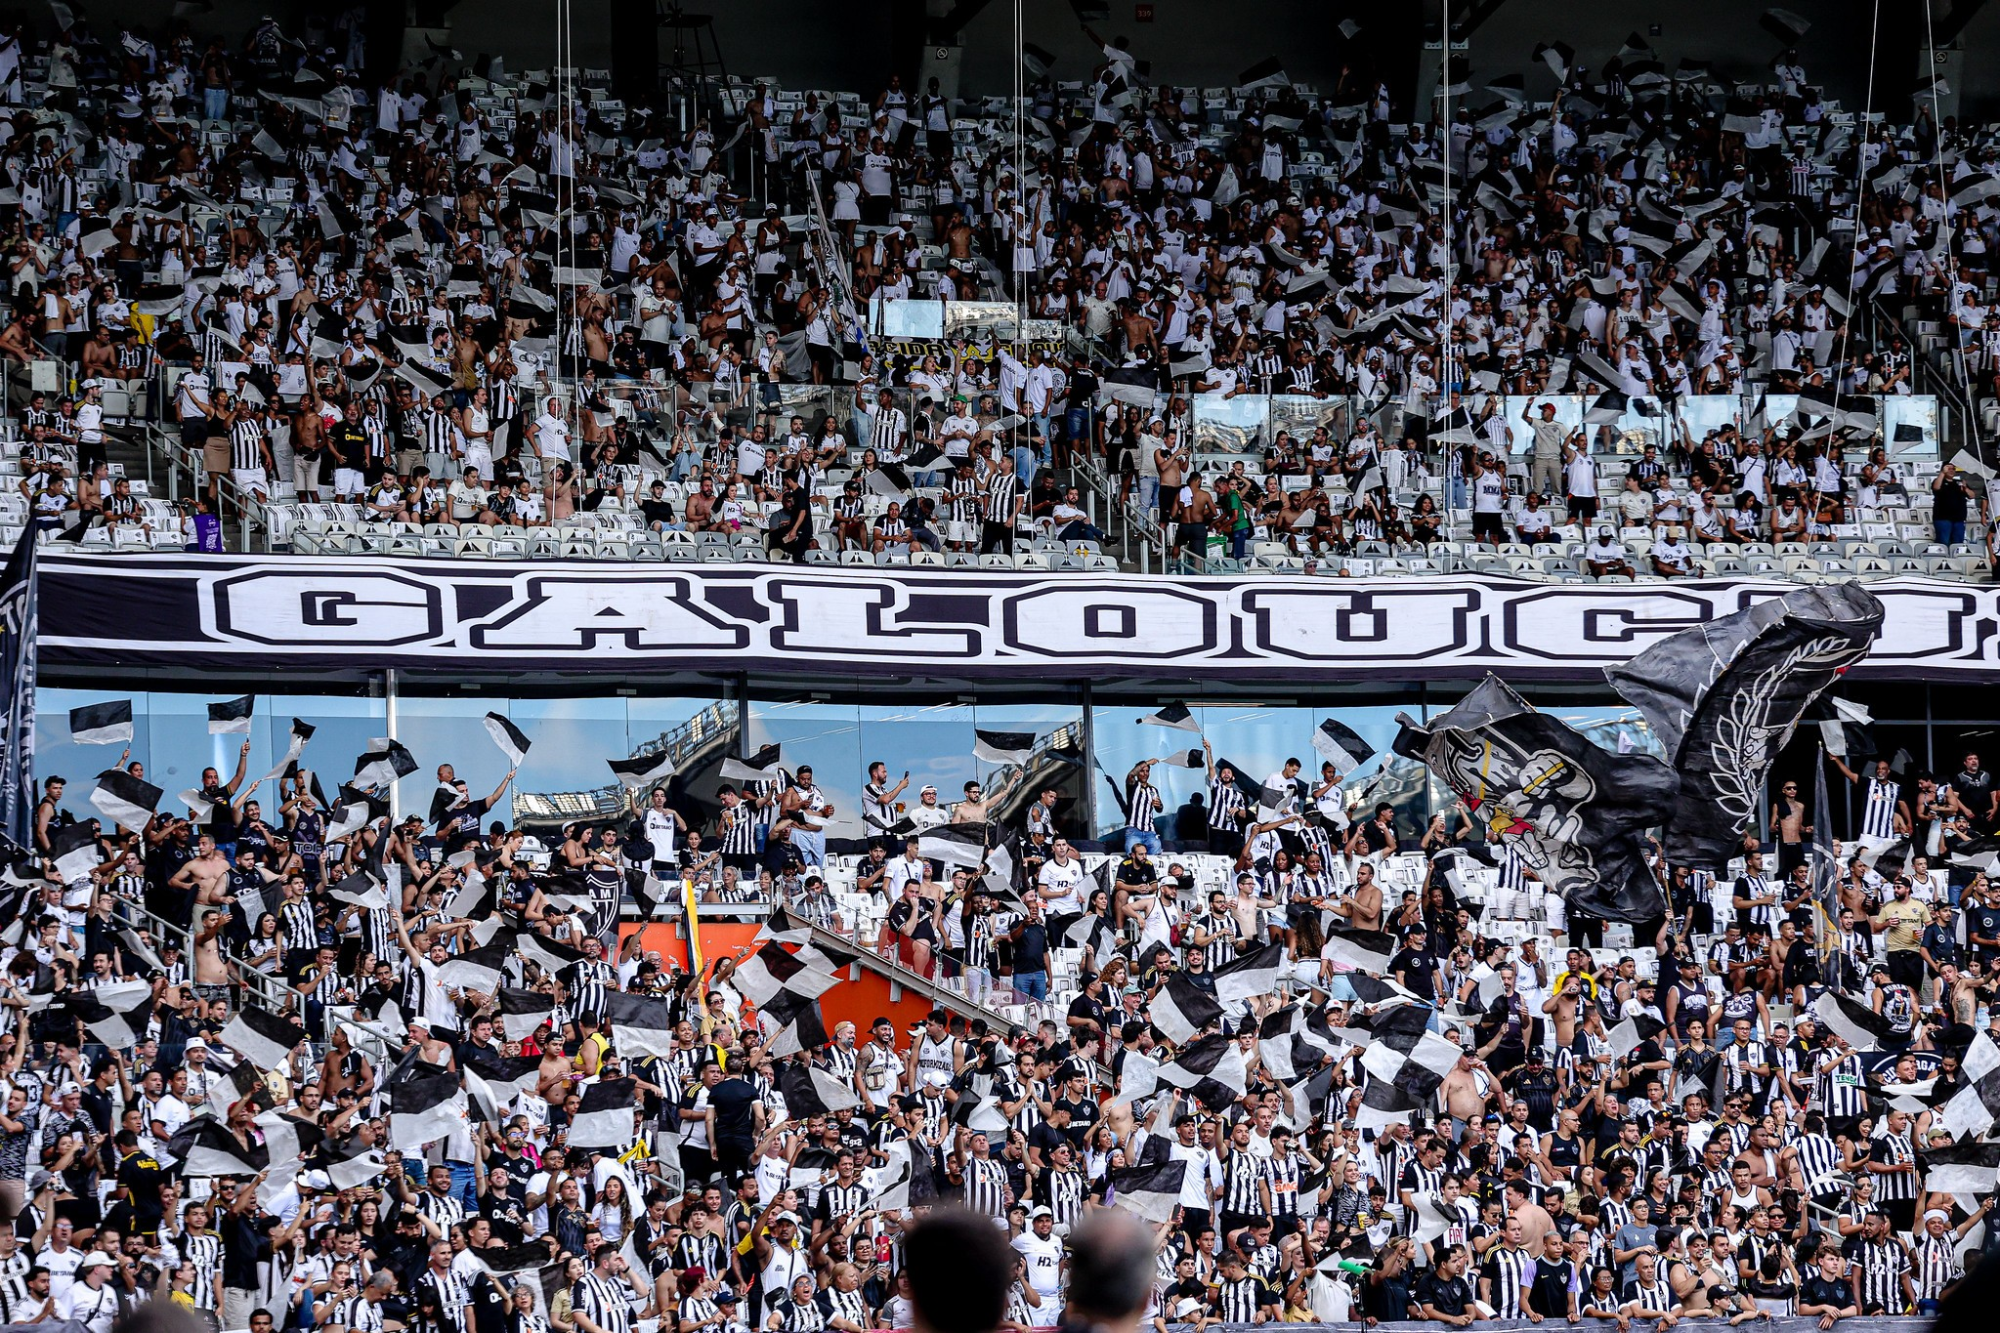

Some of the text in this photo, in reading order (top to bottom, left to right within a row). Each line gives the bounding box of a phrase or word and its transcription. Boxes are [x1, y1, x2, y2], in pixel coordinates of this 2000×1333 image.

[1137, 9, 1152, 18] 339
[1059, 1191, 1072, 1201] H2
[436, 1213, 451, 1224] H2
[1449, 1228, 1463, 1243] FIAT
[1037, 1256, 1052, 1267] H2
[1871, 1264, 1886, 1275] H2
